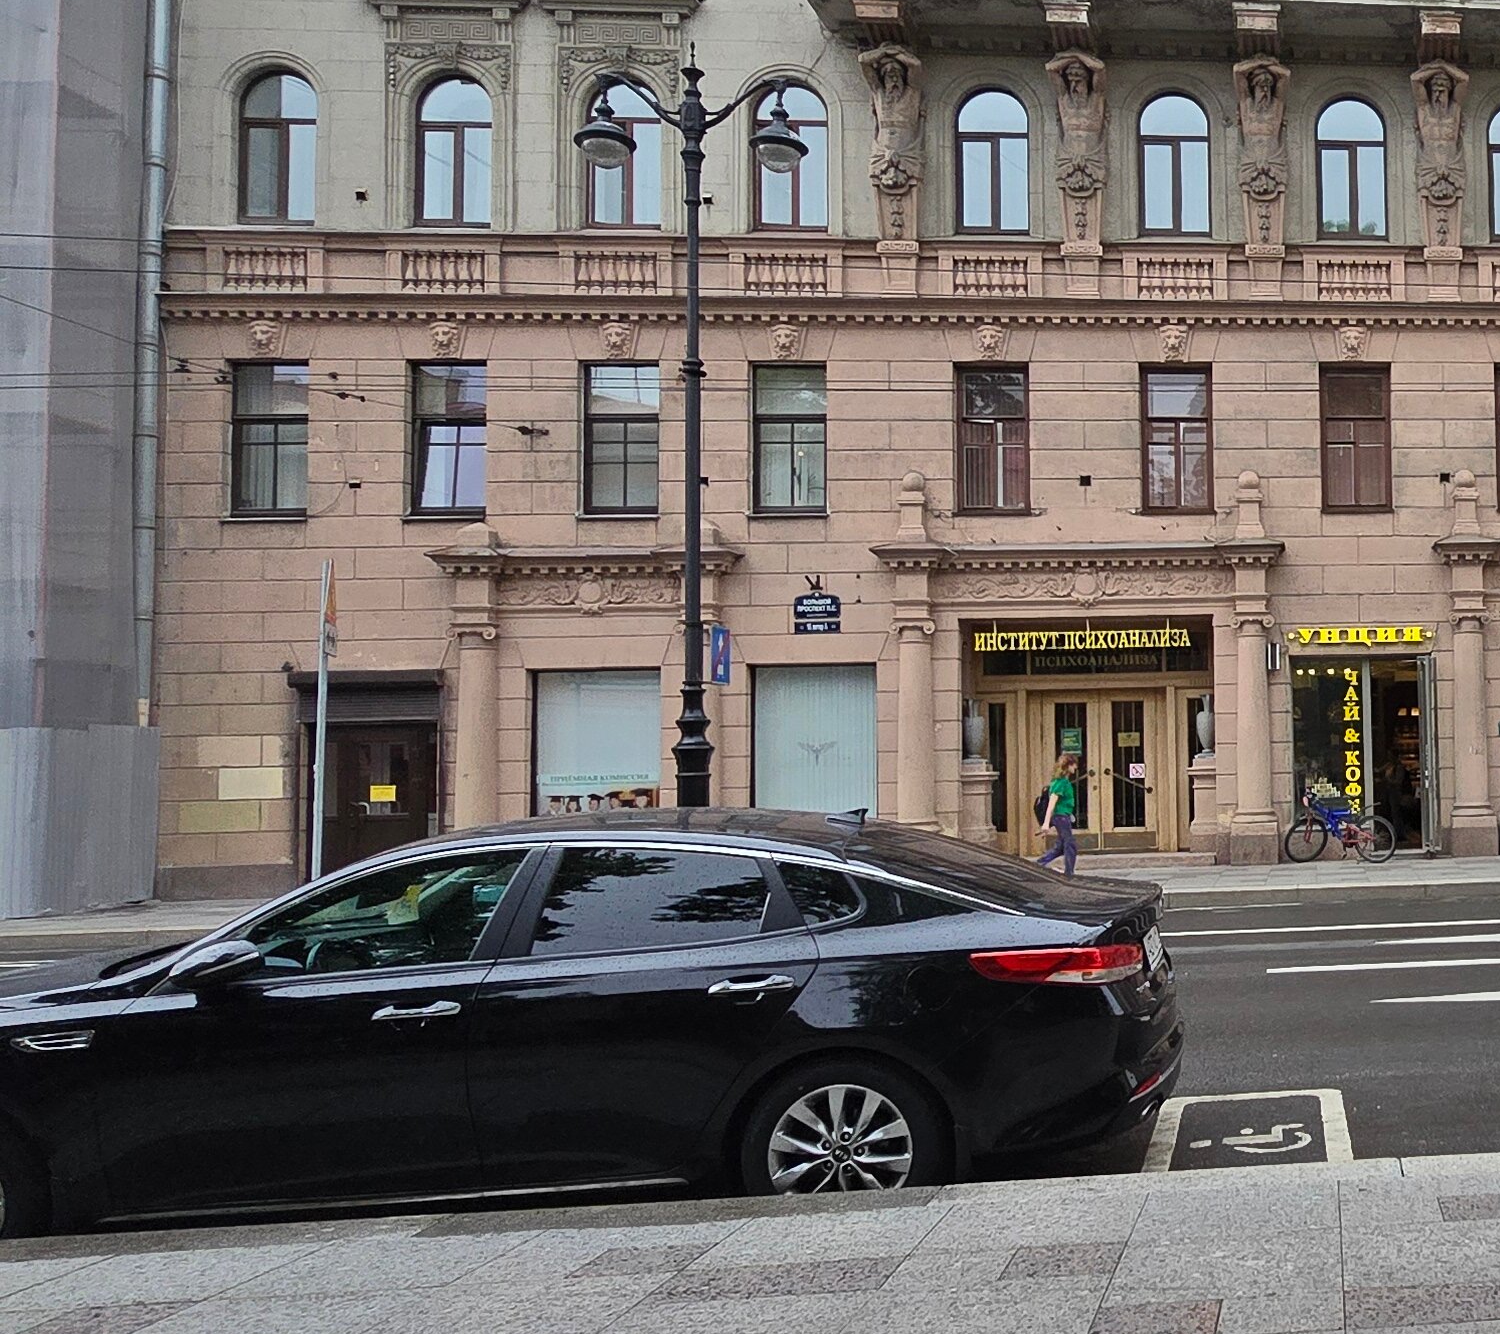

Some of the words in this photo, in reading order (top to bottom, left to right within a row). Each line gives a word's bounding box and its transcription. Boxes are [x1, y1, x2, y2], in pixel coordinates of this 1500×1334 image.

[974, 632, 1058, 651] ИНСТИТУТ
[1064, 628, 1191, 650] ПСИХОАНАЛИЗА
[1297, 626, 1423, 647] УНЦИЯ
[1035, 653, 1158, 667] ПСИХОАНАЛИЗА
[1343, 670, 1360, 721] ЧАЙ
[1343, 728, 1360, 743] &
